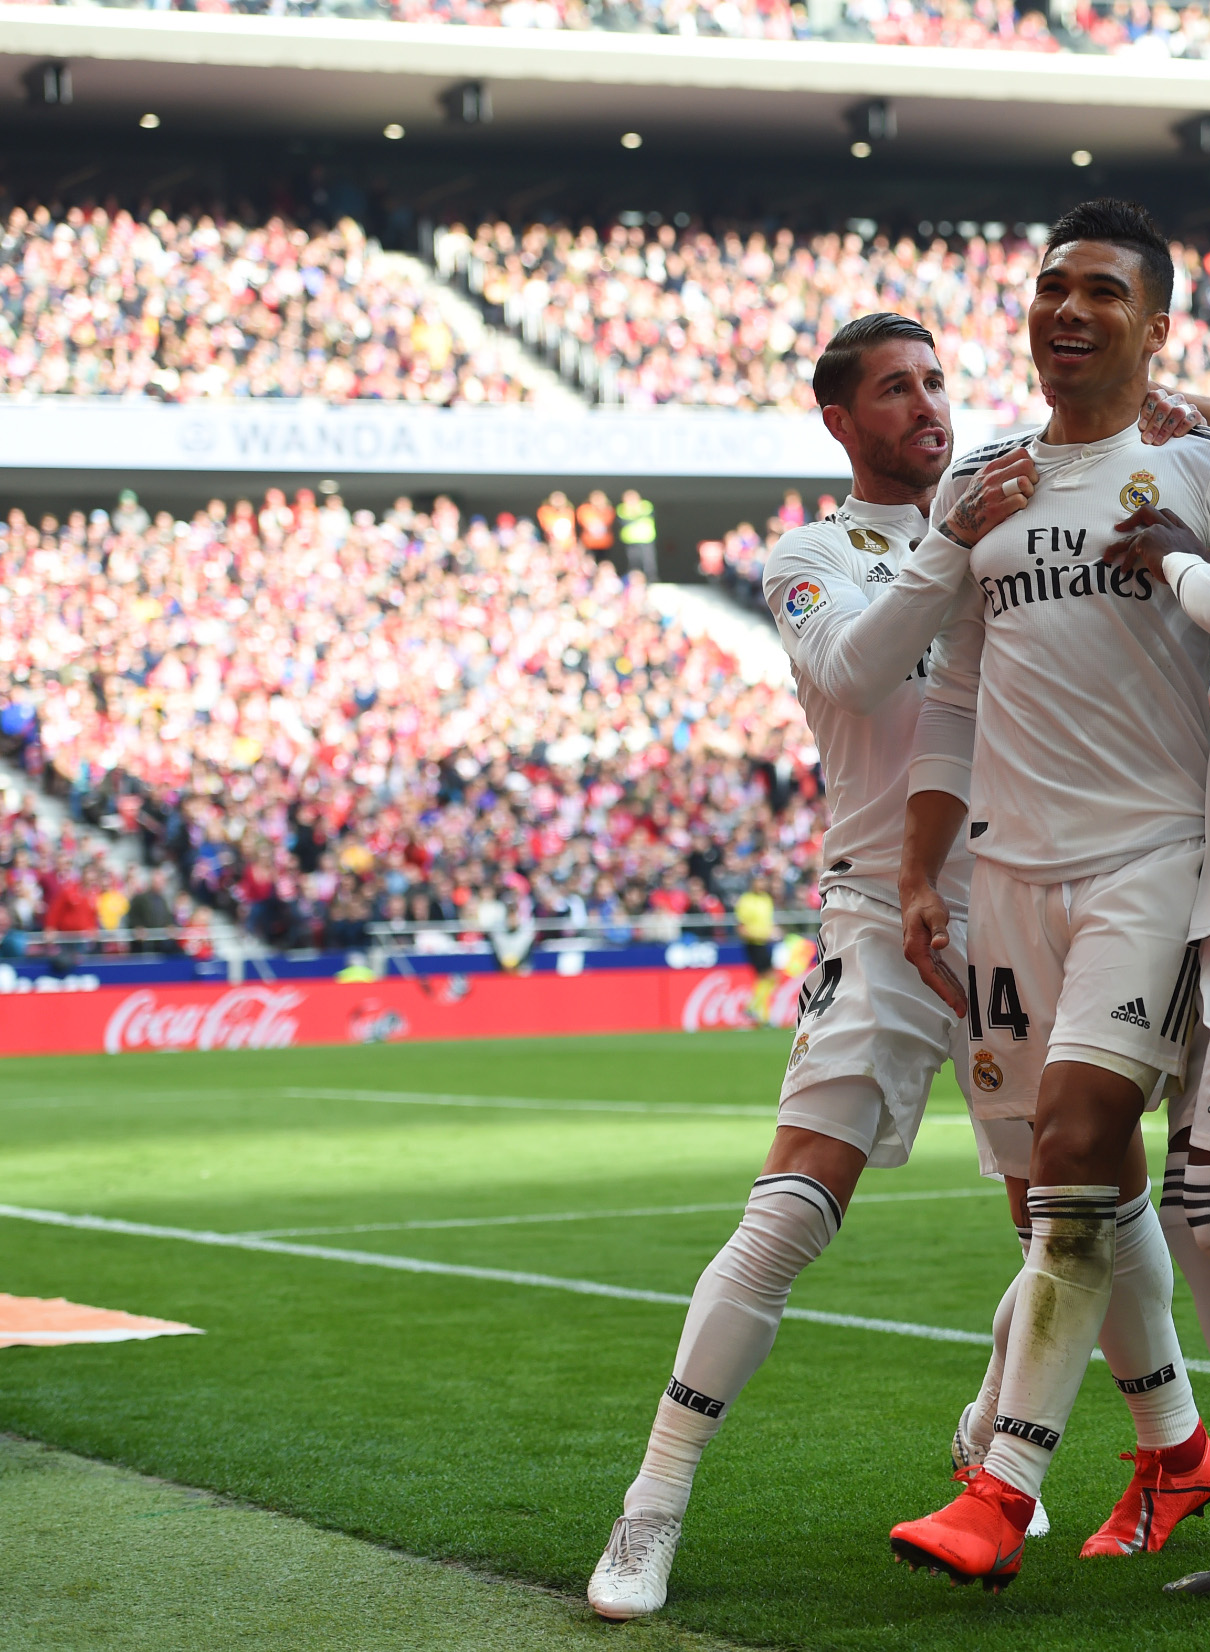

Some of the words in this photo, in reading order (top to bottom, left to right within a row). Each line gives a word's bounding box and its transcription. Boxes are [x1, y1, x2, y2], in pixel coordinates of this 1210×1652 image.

[230, 419, 419, 459] WANDA
[1026, 526, 1087, 557] Fly
[979, 557, 1153, 619] Emirates
[804, 957, 843, 1021] 4
[967, 964, 1030, 1041] 14
[1110, 1010, 1151, 1030] adidas
[995, 1415, 1059, 1446] RMCF
